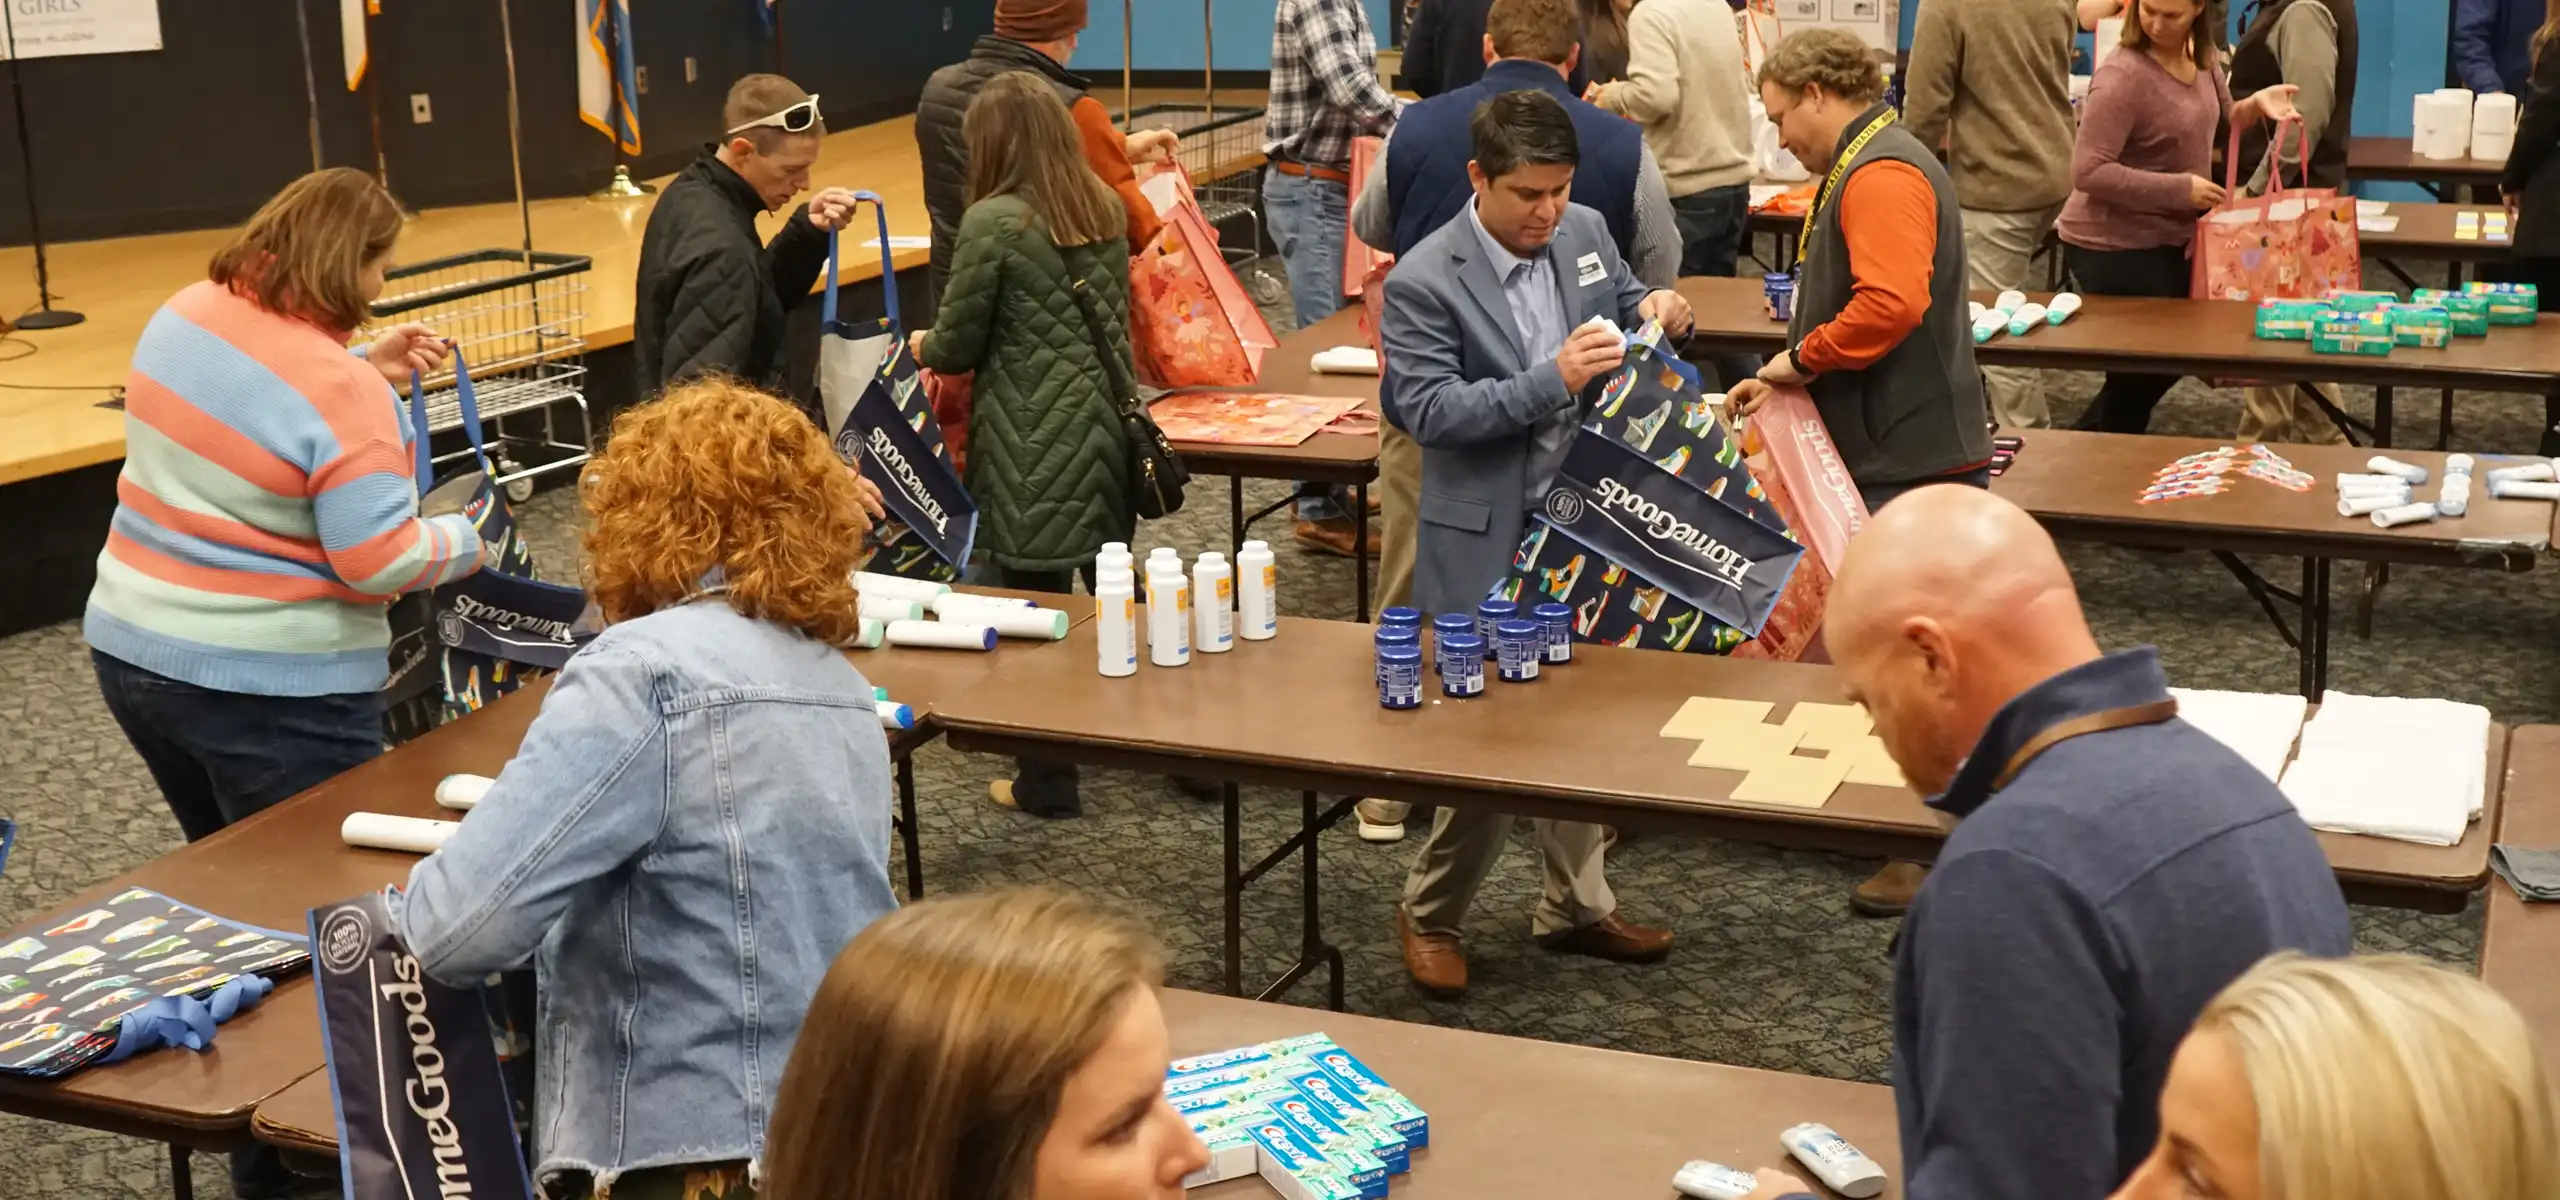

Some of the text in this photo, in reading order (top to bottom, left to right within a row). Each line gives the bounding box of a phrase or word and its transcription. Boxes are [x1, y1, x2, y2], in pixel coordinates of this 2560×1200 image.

[868, 426, 951, 536] HomeGoods
[1799, 419, 1863, 533] meGoods
[1593, 476, 1756, 586] HomeGoods
[455, 594, 576, 644] HomeGoods
[332, 922, 357, 942] 100%
[380, 951, 473, 1200] meGoods
[1327, 1055, 1368, 1089] Crest
[1307, 1079, 1348, 1112] Crest
[1286, 1103, 1327, 1137] Crest
[1264, 1127, 1305, 1161] Crest
